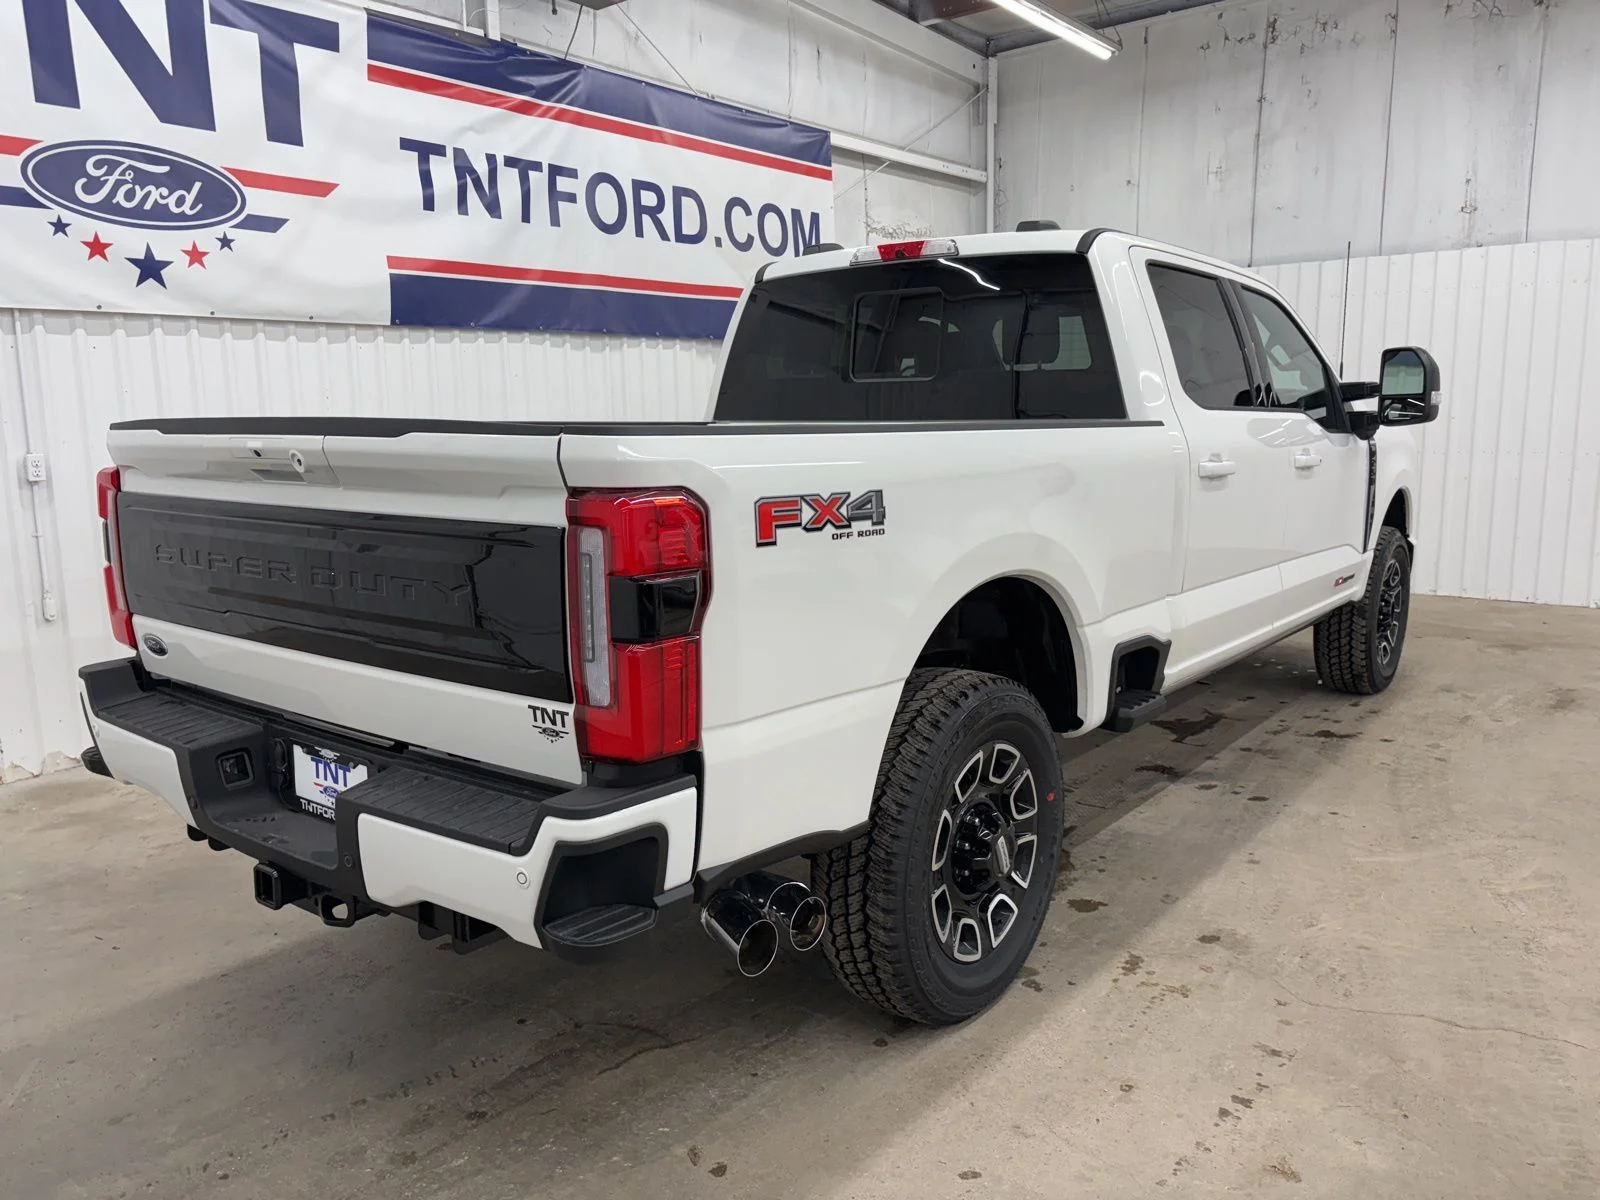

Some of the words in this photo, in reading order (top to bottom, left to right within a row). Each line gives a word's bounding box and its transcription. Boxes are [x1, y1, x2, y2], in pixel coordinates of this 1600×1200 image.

[74, 153, 204, 217] Ford
[399, 136, 821, 258] TNTFORD.COM
[754, 489, 886, 548] FX4
[831, 531, 854, 541] OFF
[857, 528, 885, 538] ROAD
[155, 543, 297, 584] SUPER
[310, 563, 471, 606] DUTY
[527, 704, 570, 728] TNT
[310, 756, 351, 788] TNT
